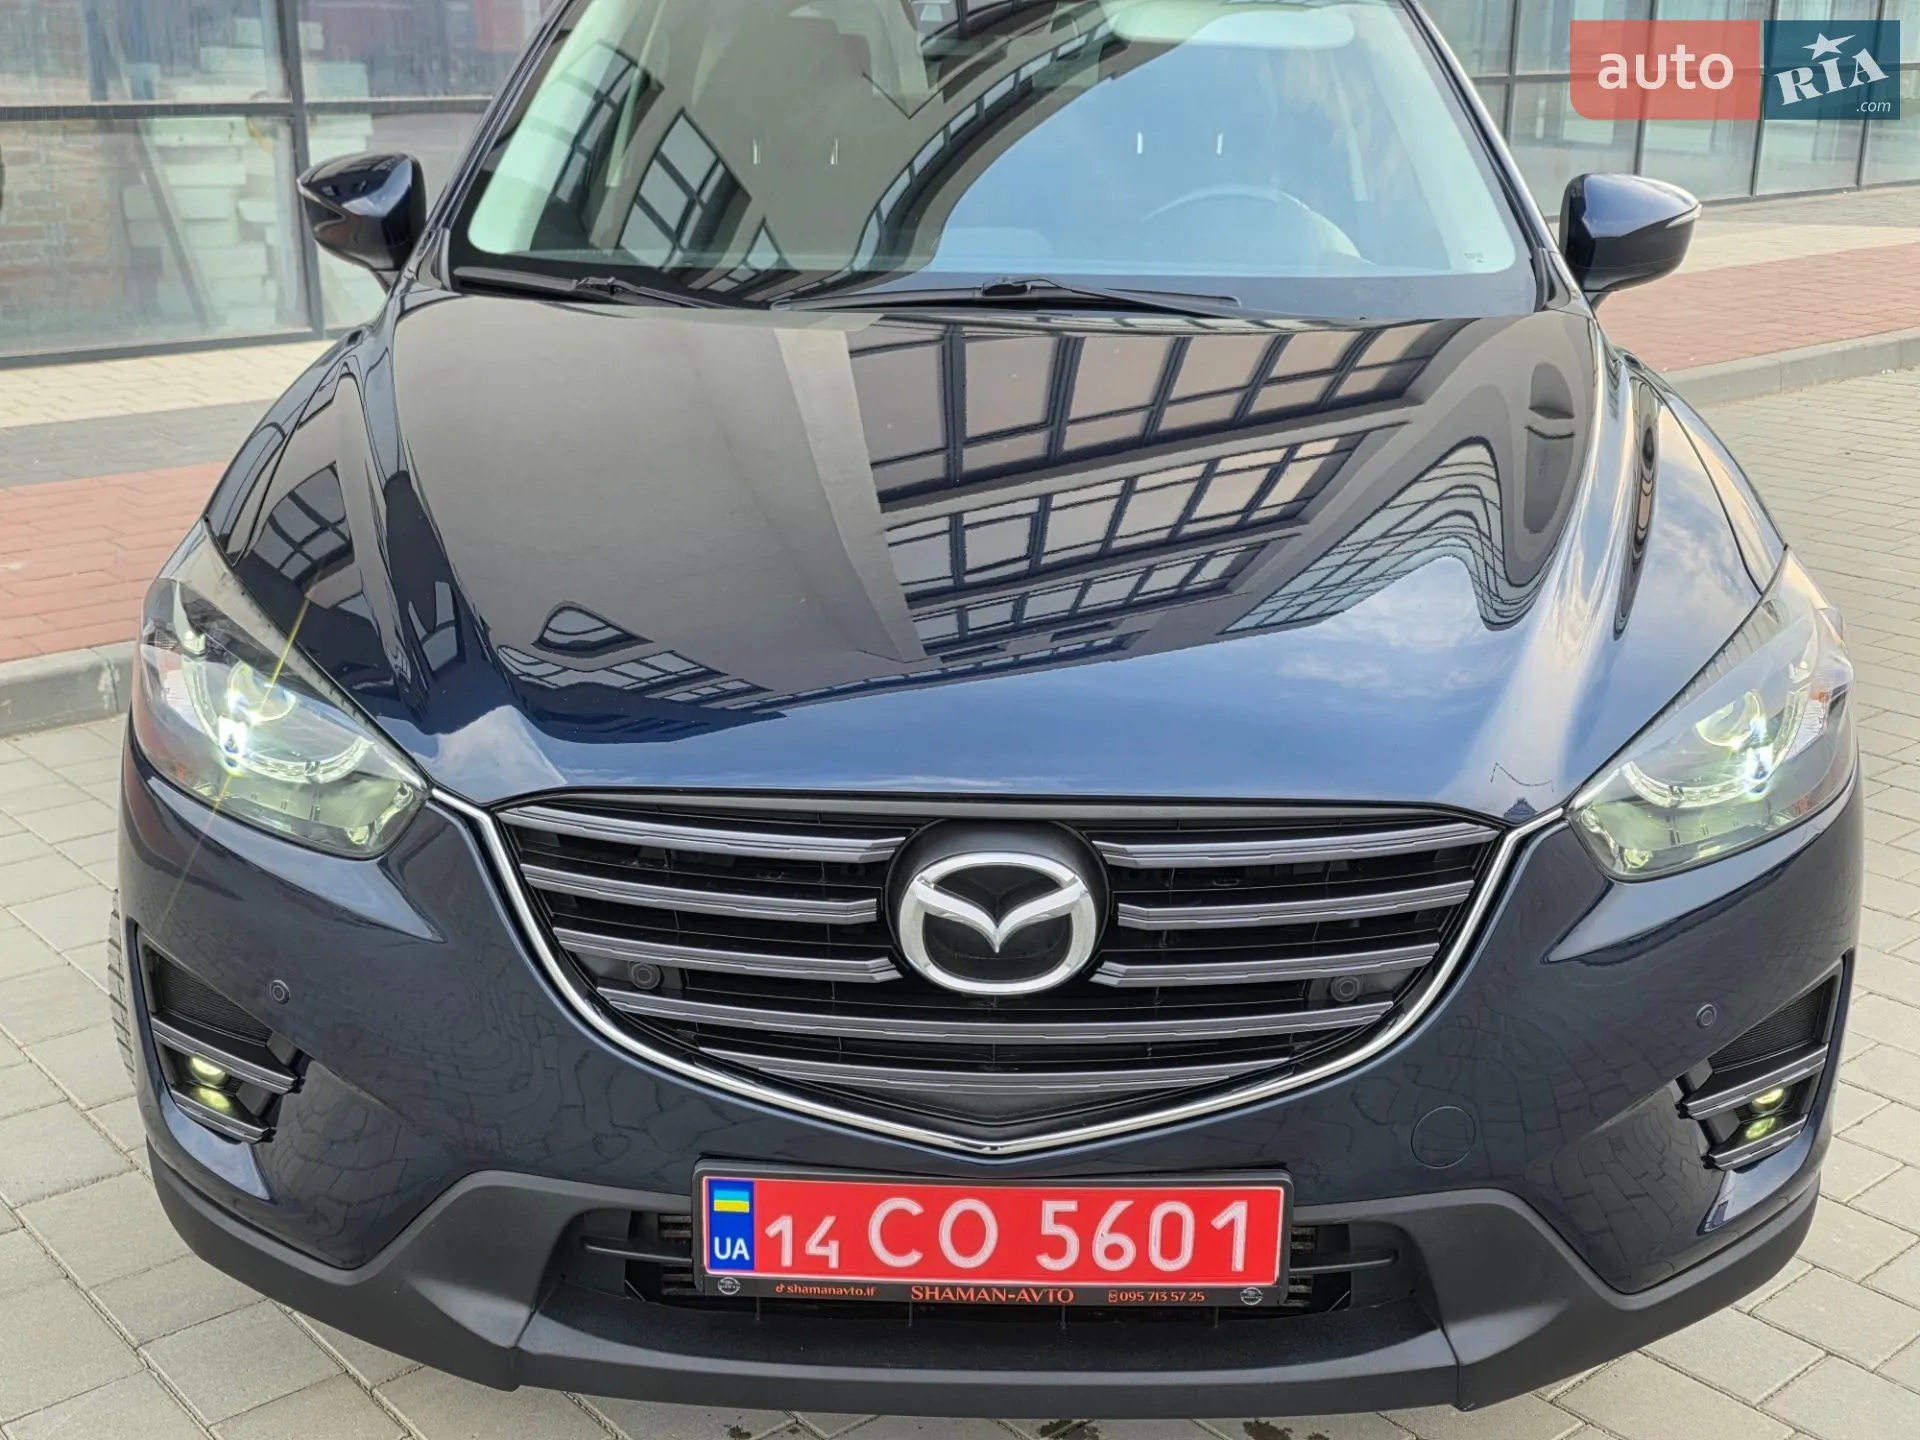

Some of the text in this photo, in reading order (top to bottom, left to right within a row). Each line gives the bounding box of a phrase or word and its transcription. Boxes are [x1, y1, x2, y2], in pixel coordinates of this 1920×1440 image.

[765, 1197, 1248, 1272] 14 CO 5601
[714, 1236, 750, 1261] UA
[911, 1285, 1074, 1304] SHAMAN-AVTO
[1120, 1291, 1205, 1303] 095 713 57 25
